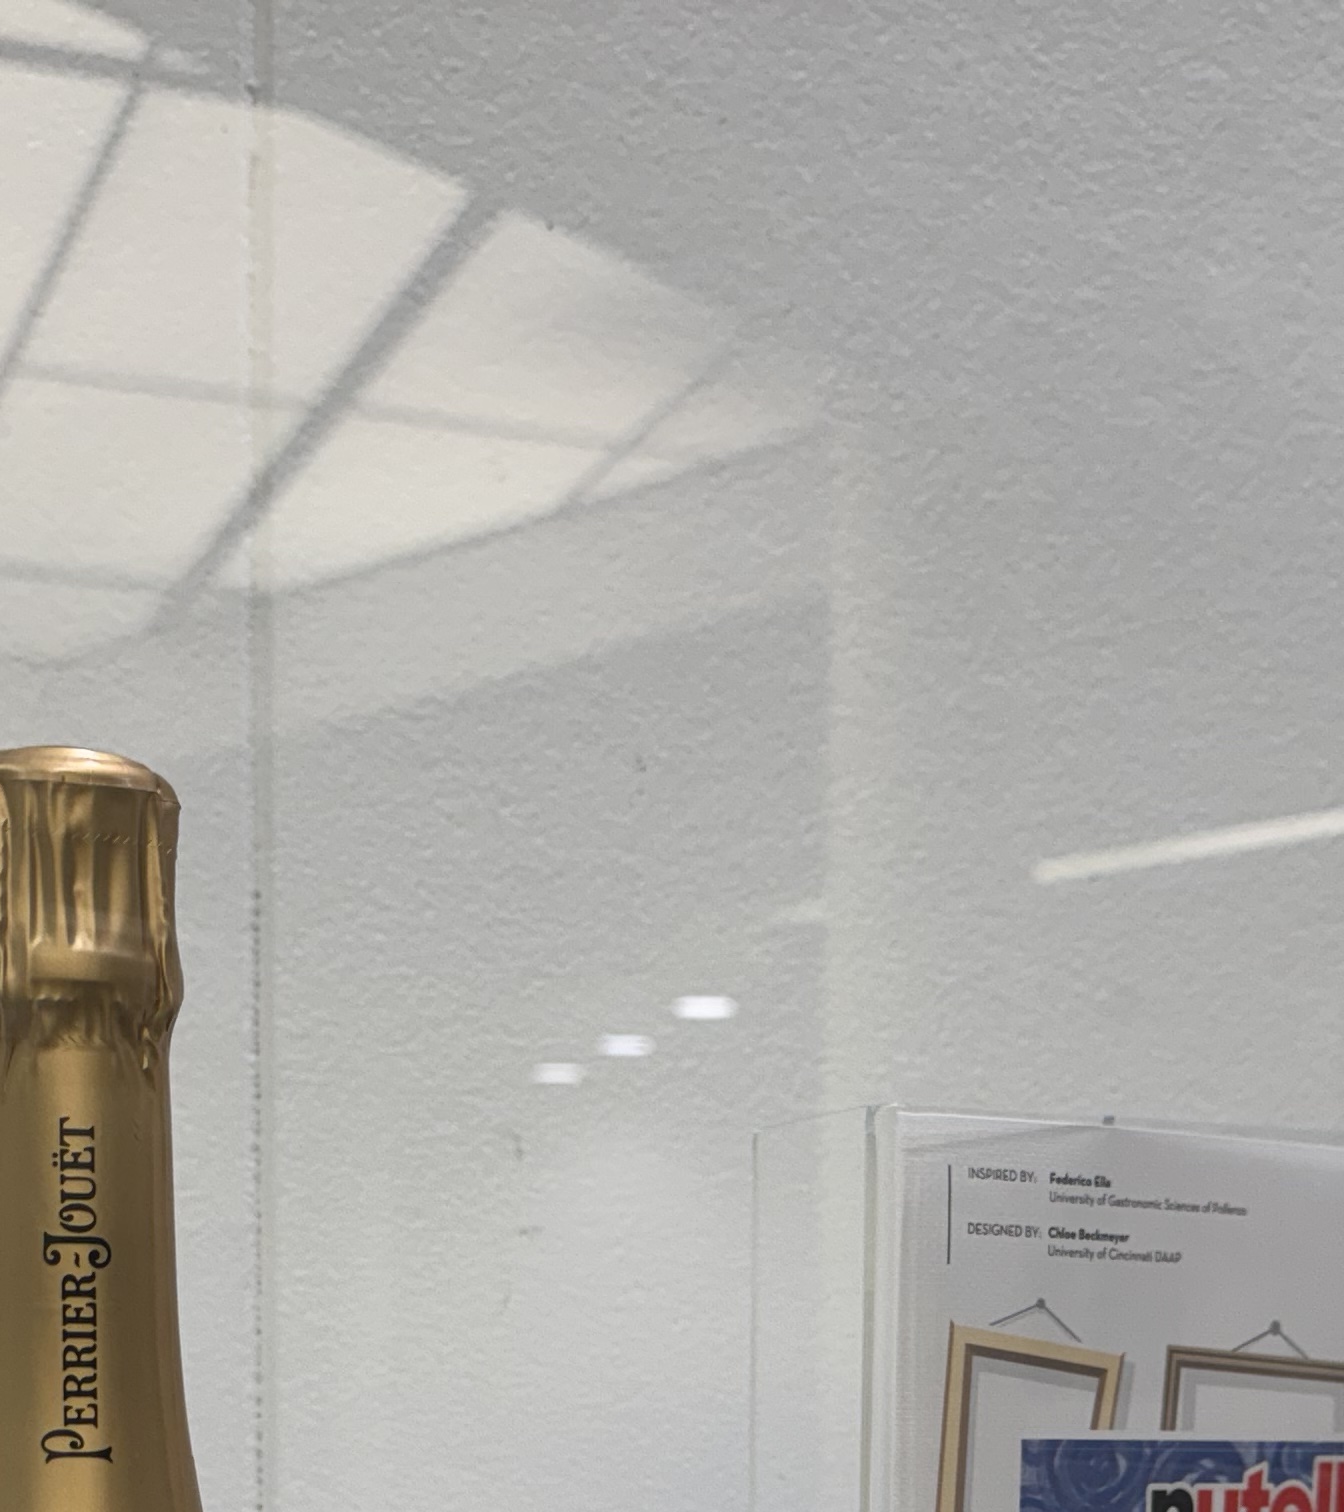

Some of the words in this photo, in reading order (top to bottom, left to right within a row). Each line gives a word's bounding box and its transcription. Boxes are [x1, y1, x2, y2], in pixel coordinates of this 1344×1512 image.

[968, 1167, 1017, 1183] INSPIRED
[1049, 1172, 1092, 1187] Federico
[1049, 1191, 1094, 1208] University
[1097, 1193, 1108, 1206] of
[967, 1222, 1023, 1238] DESIGNED
[1047, 1245, 1094, 1261] University
[1096, 1247, 1107, 1260] of
